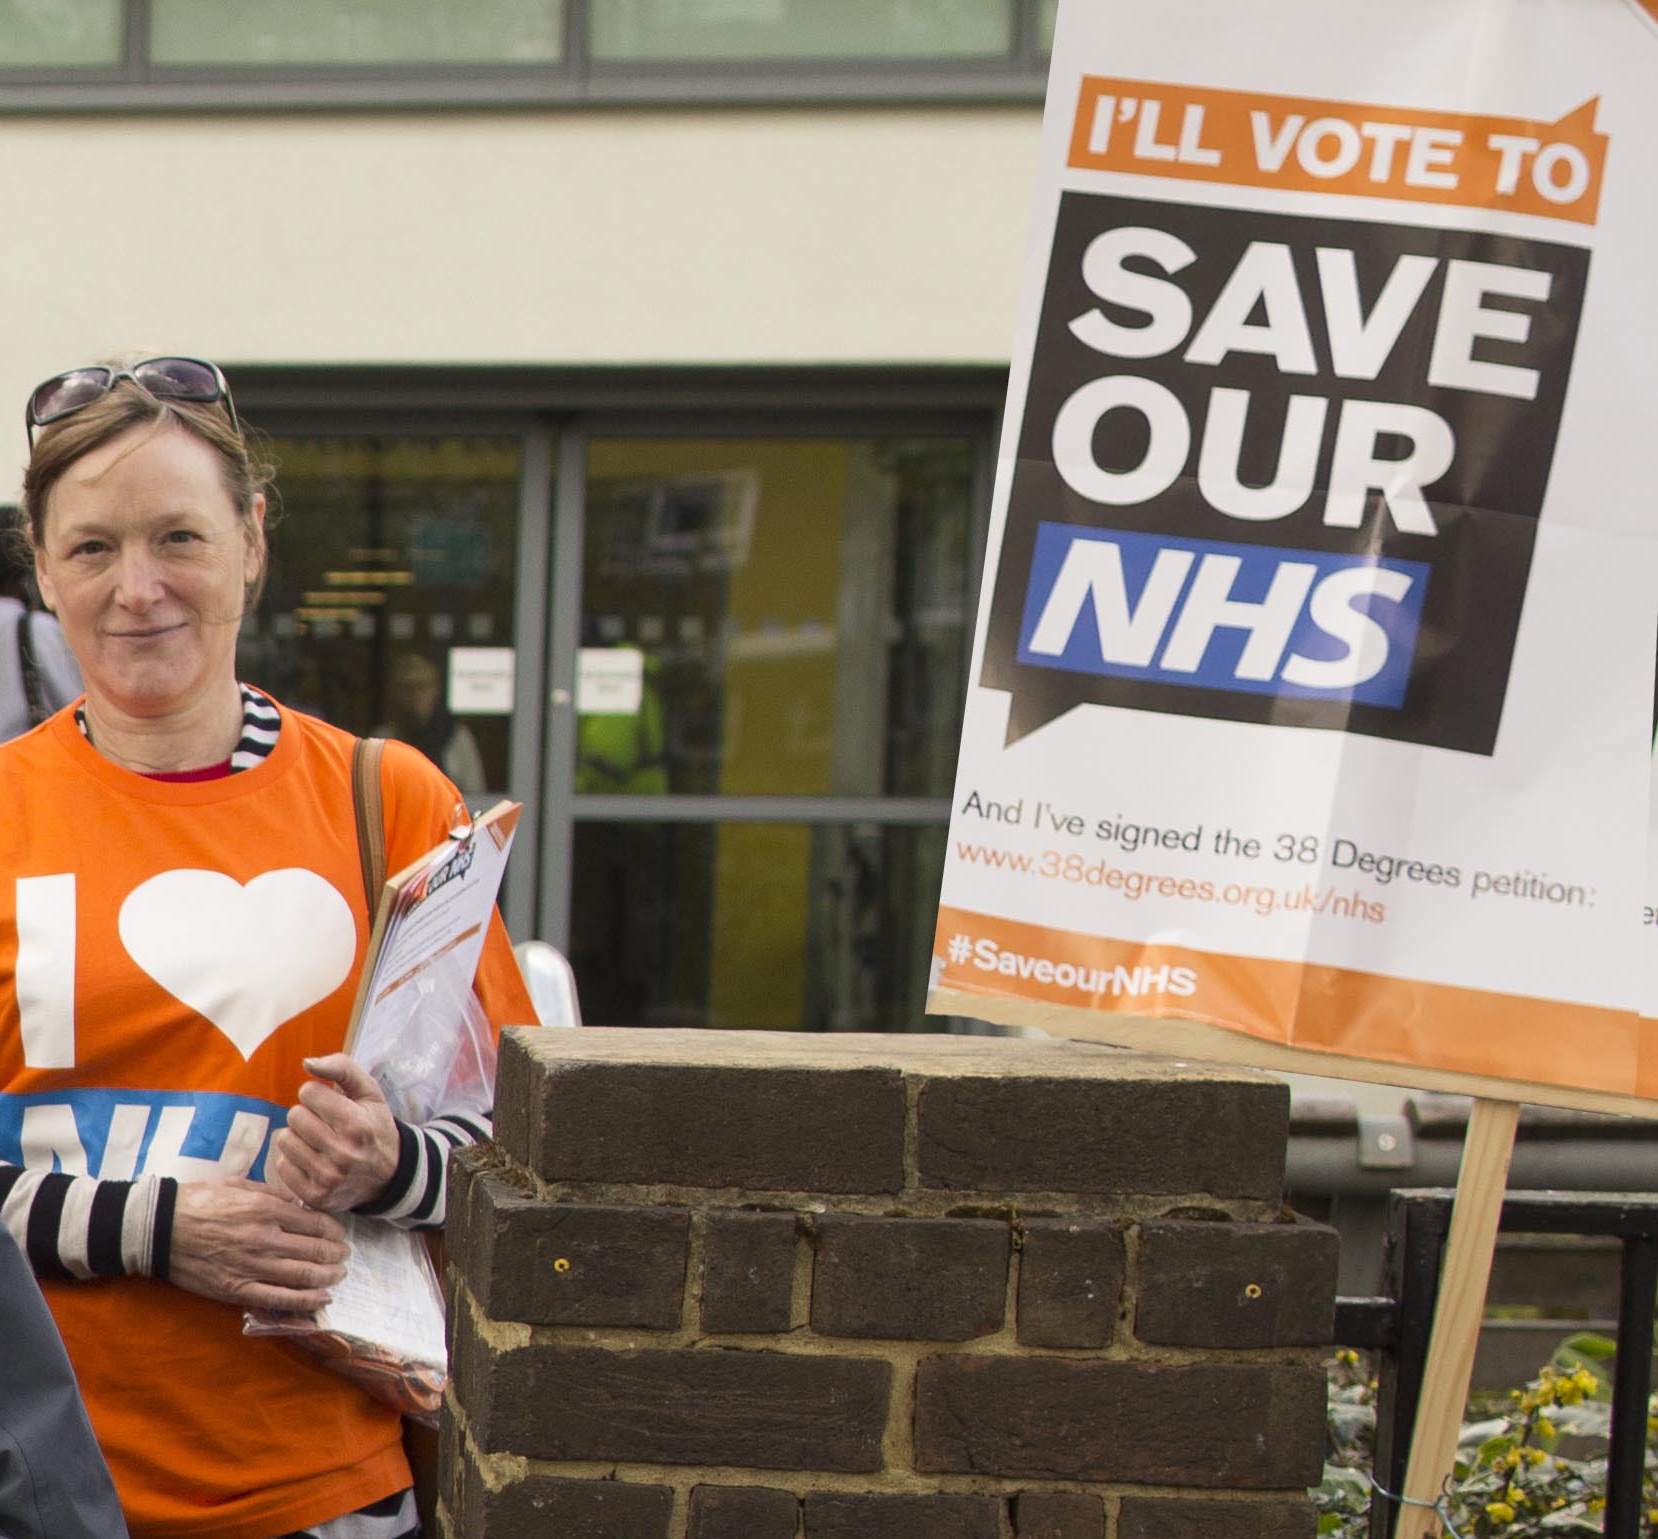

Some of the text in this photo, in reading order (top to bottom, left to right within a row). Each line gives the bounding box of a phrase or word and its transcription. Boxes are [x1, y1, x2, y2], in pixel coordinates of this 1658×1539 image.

[1088, 94, 1591, 204] I'LL VOTE TO
[1067, 225, 1554, 400] SAVE
[1051, 374, 1456, 537] OUR
[1029, 537, 1414, 690] NHS
[956, 840, 1387, 924] www.38degrees.org.uk/nhs
[962, 790, 1598, 909] And I've signed the 38 Degrees petition:
[15, 872, 77, 1069] I
[948, 932, 1198, 997] #SaveourNHS
